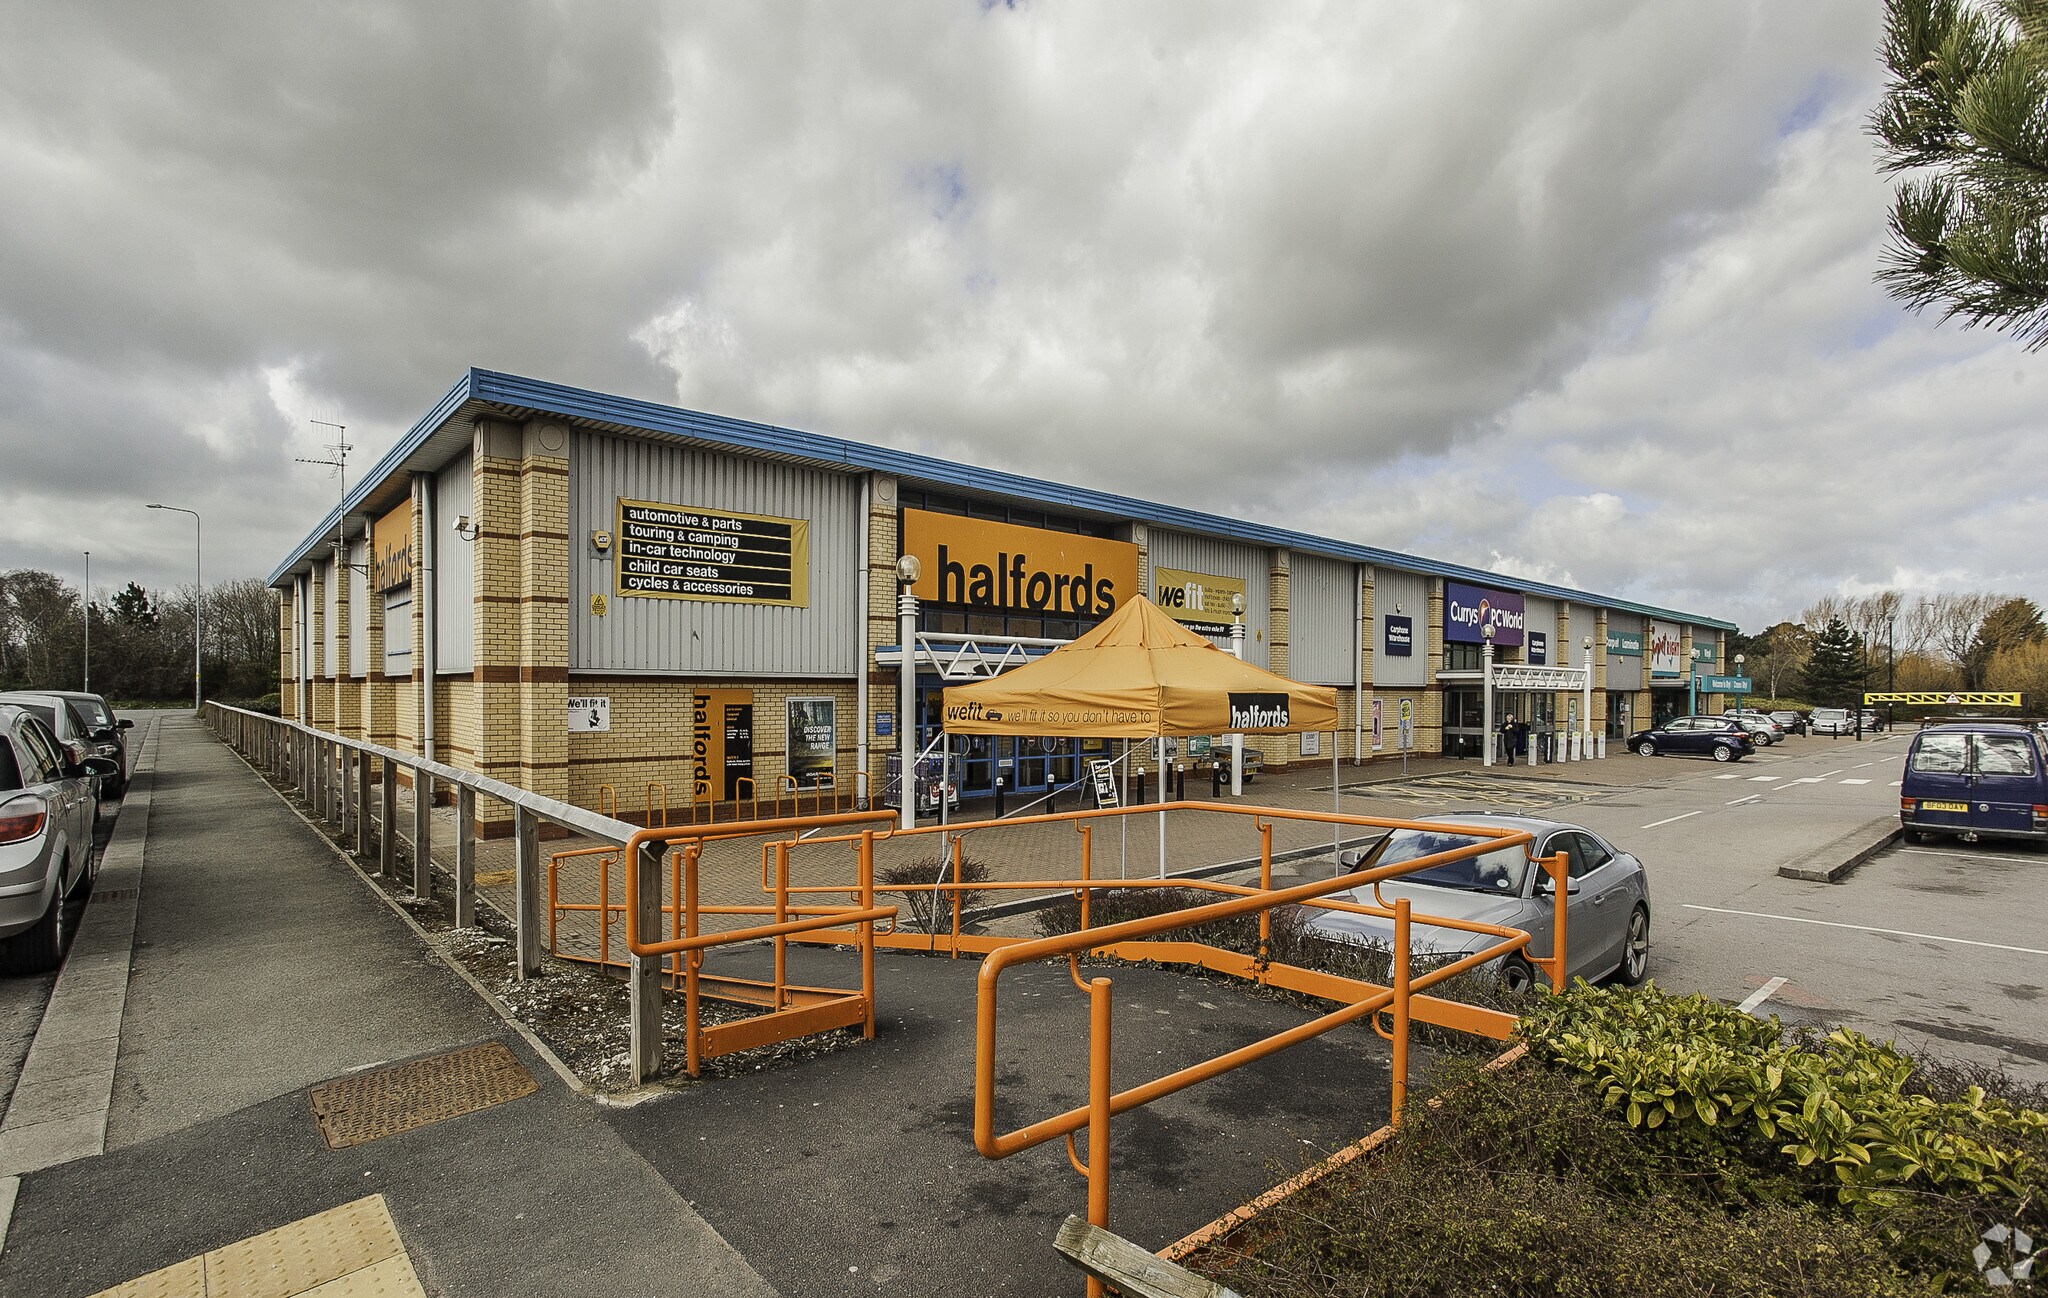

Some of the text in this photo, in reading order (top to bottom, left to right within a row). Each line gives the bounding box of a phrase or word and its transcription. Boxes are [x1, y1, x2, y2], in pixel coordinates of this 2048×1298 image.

[629, 509, 742, 530] automotive & parts
[630, 524, 739, 548] touring & camping
[629, 541, 736, 564] in-car technology
[629, 559, 719, 578] child car seats
[628, 577, 753, 595] cycles & accessories
[937, 543, 1116, 616] halfords
[1450, 601, 1523, 629] Currys PC World
[568, 699, 606, 708] We'll fit it
[947, 701, 983, 721] wefit
[1007, 709, 1151, 725] we'll fit it so you don't have to
[1231, 705, 1289, 728] halfords
[803, 725, 832, 734] DISCOVER
[694, 695, 711, 795] halfords
[810, 742, 829, 750] RANGE
